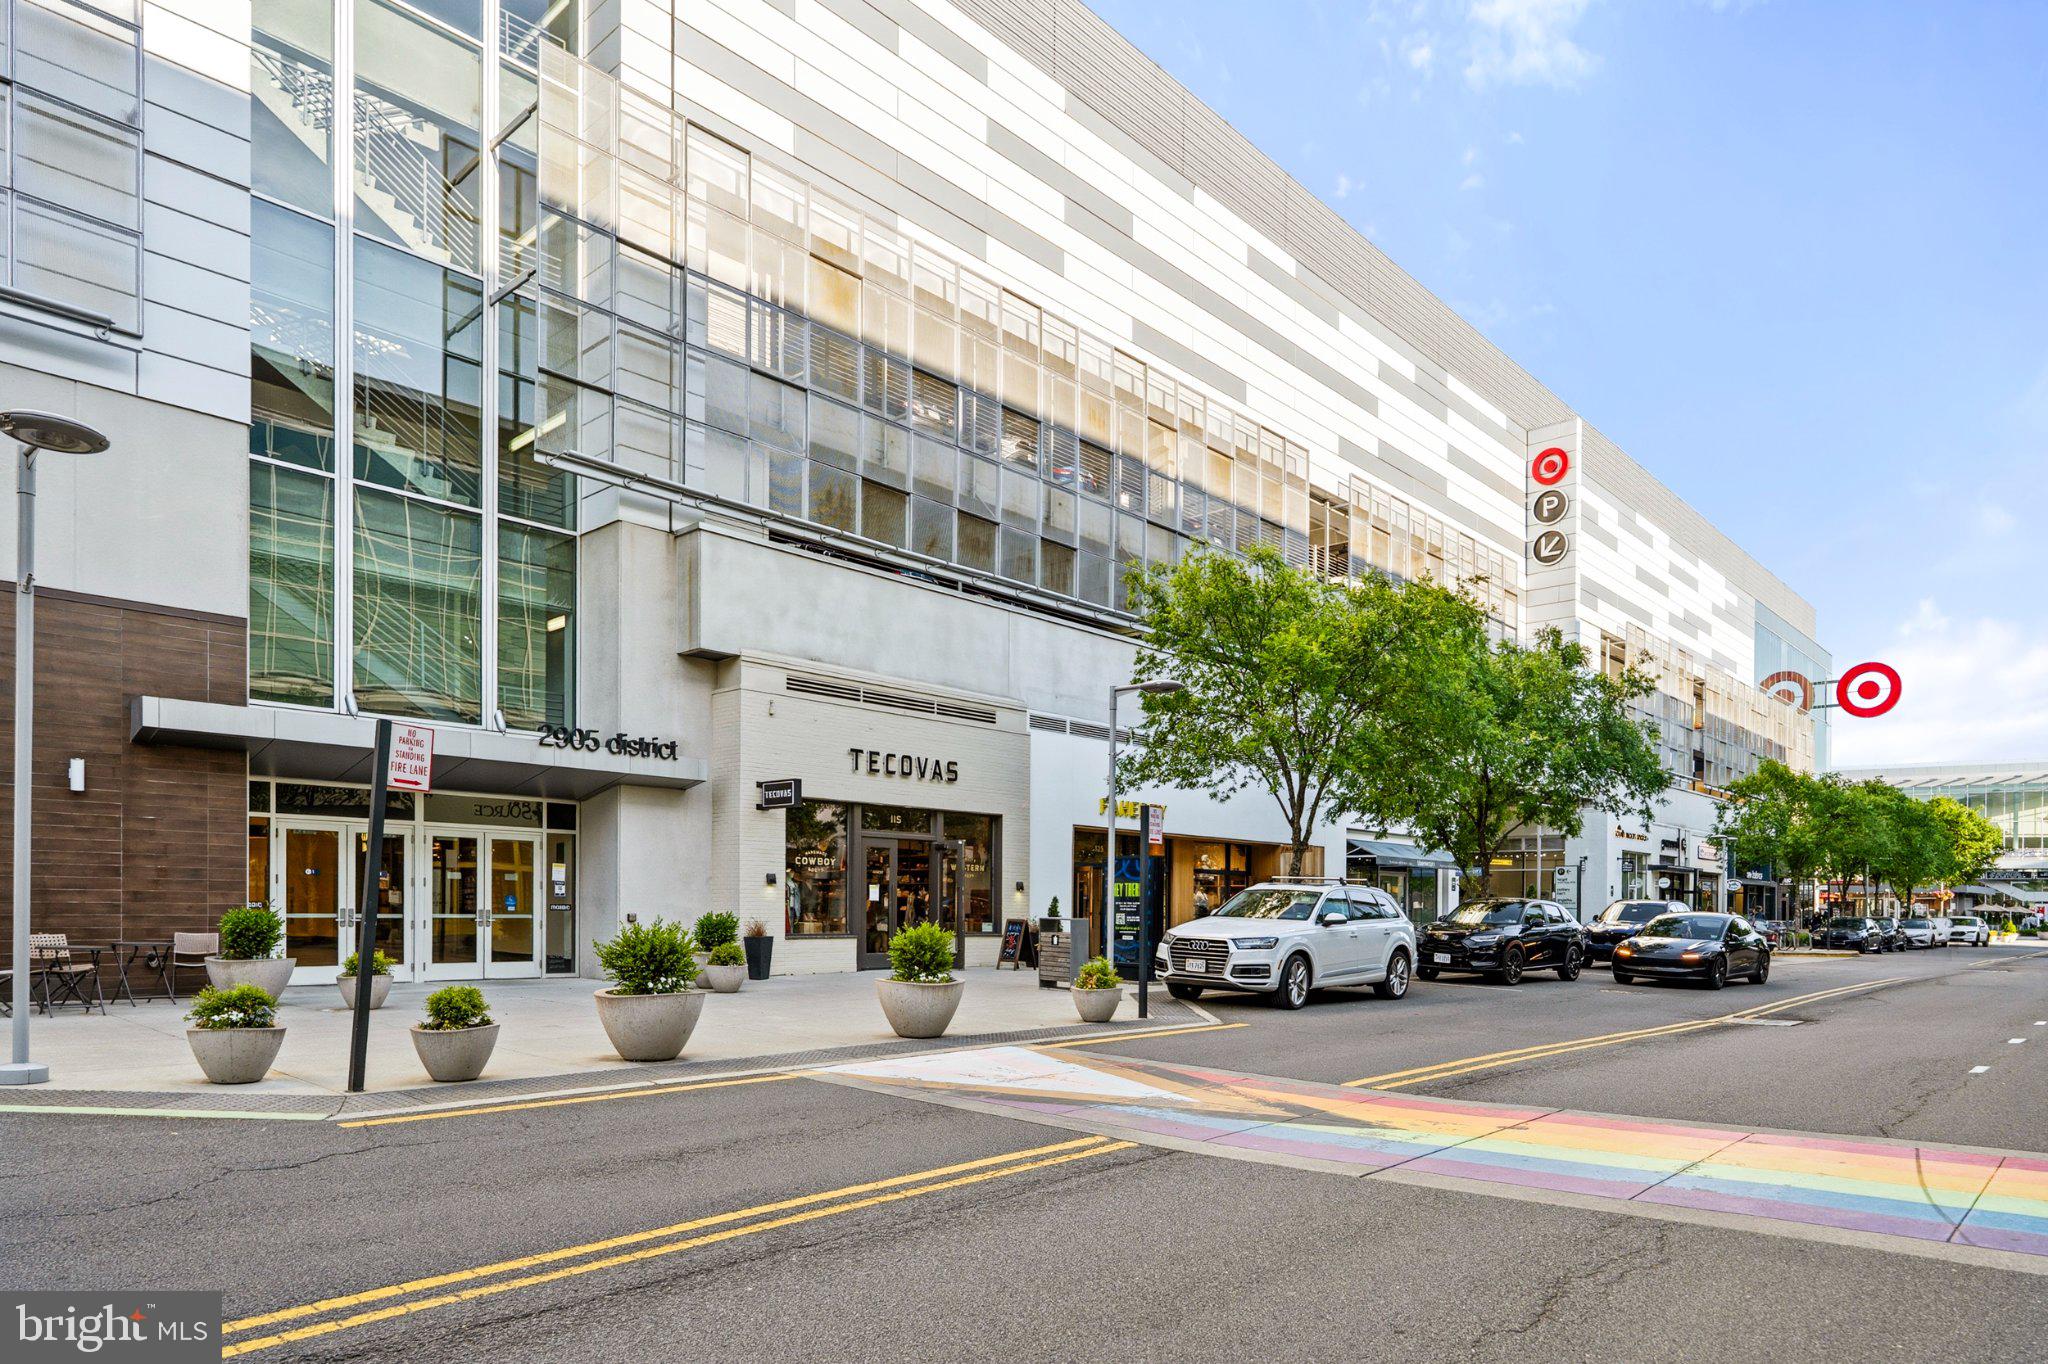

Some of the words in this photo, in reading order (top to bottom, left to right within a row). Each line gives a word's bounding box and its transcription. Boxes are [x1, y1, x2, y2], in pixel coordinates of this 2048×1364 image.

[1542, 496, 1559, 518] P
[407, 728, 417, 738] NO
[398, 736, 425, 748] PARKING
[537, 724, 601, 752] 2905
[604, 732, 679, 761] district
[395, 750, 425, 763] STANDING
[390, 761, 407, 773] FIRE
[409, 764, 429, 776] LANE
[848, 748, 959, 783] TECOVAS
[765, 788, 792, 800] TECOVAS
[1099, 797, 1168, 820] FHEY
[890, 814, 902, 824] 115
[795, 856, 837, 866] COWBOY
[950, 863, 985, 872] WTERN
[1124, 882, 1141, 897] THER
